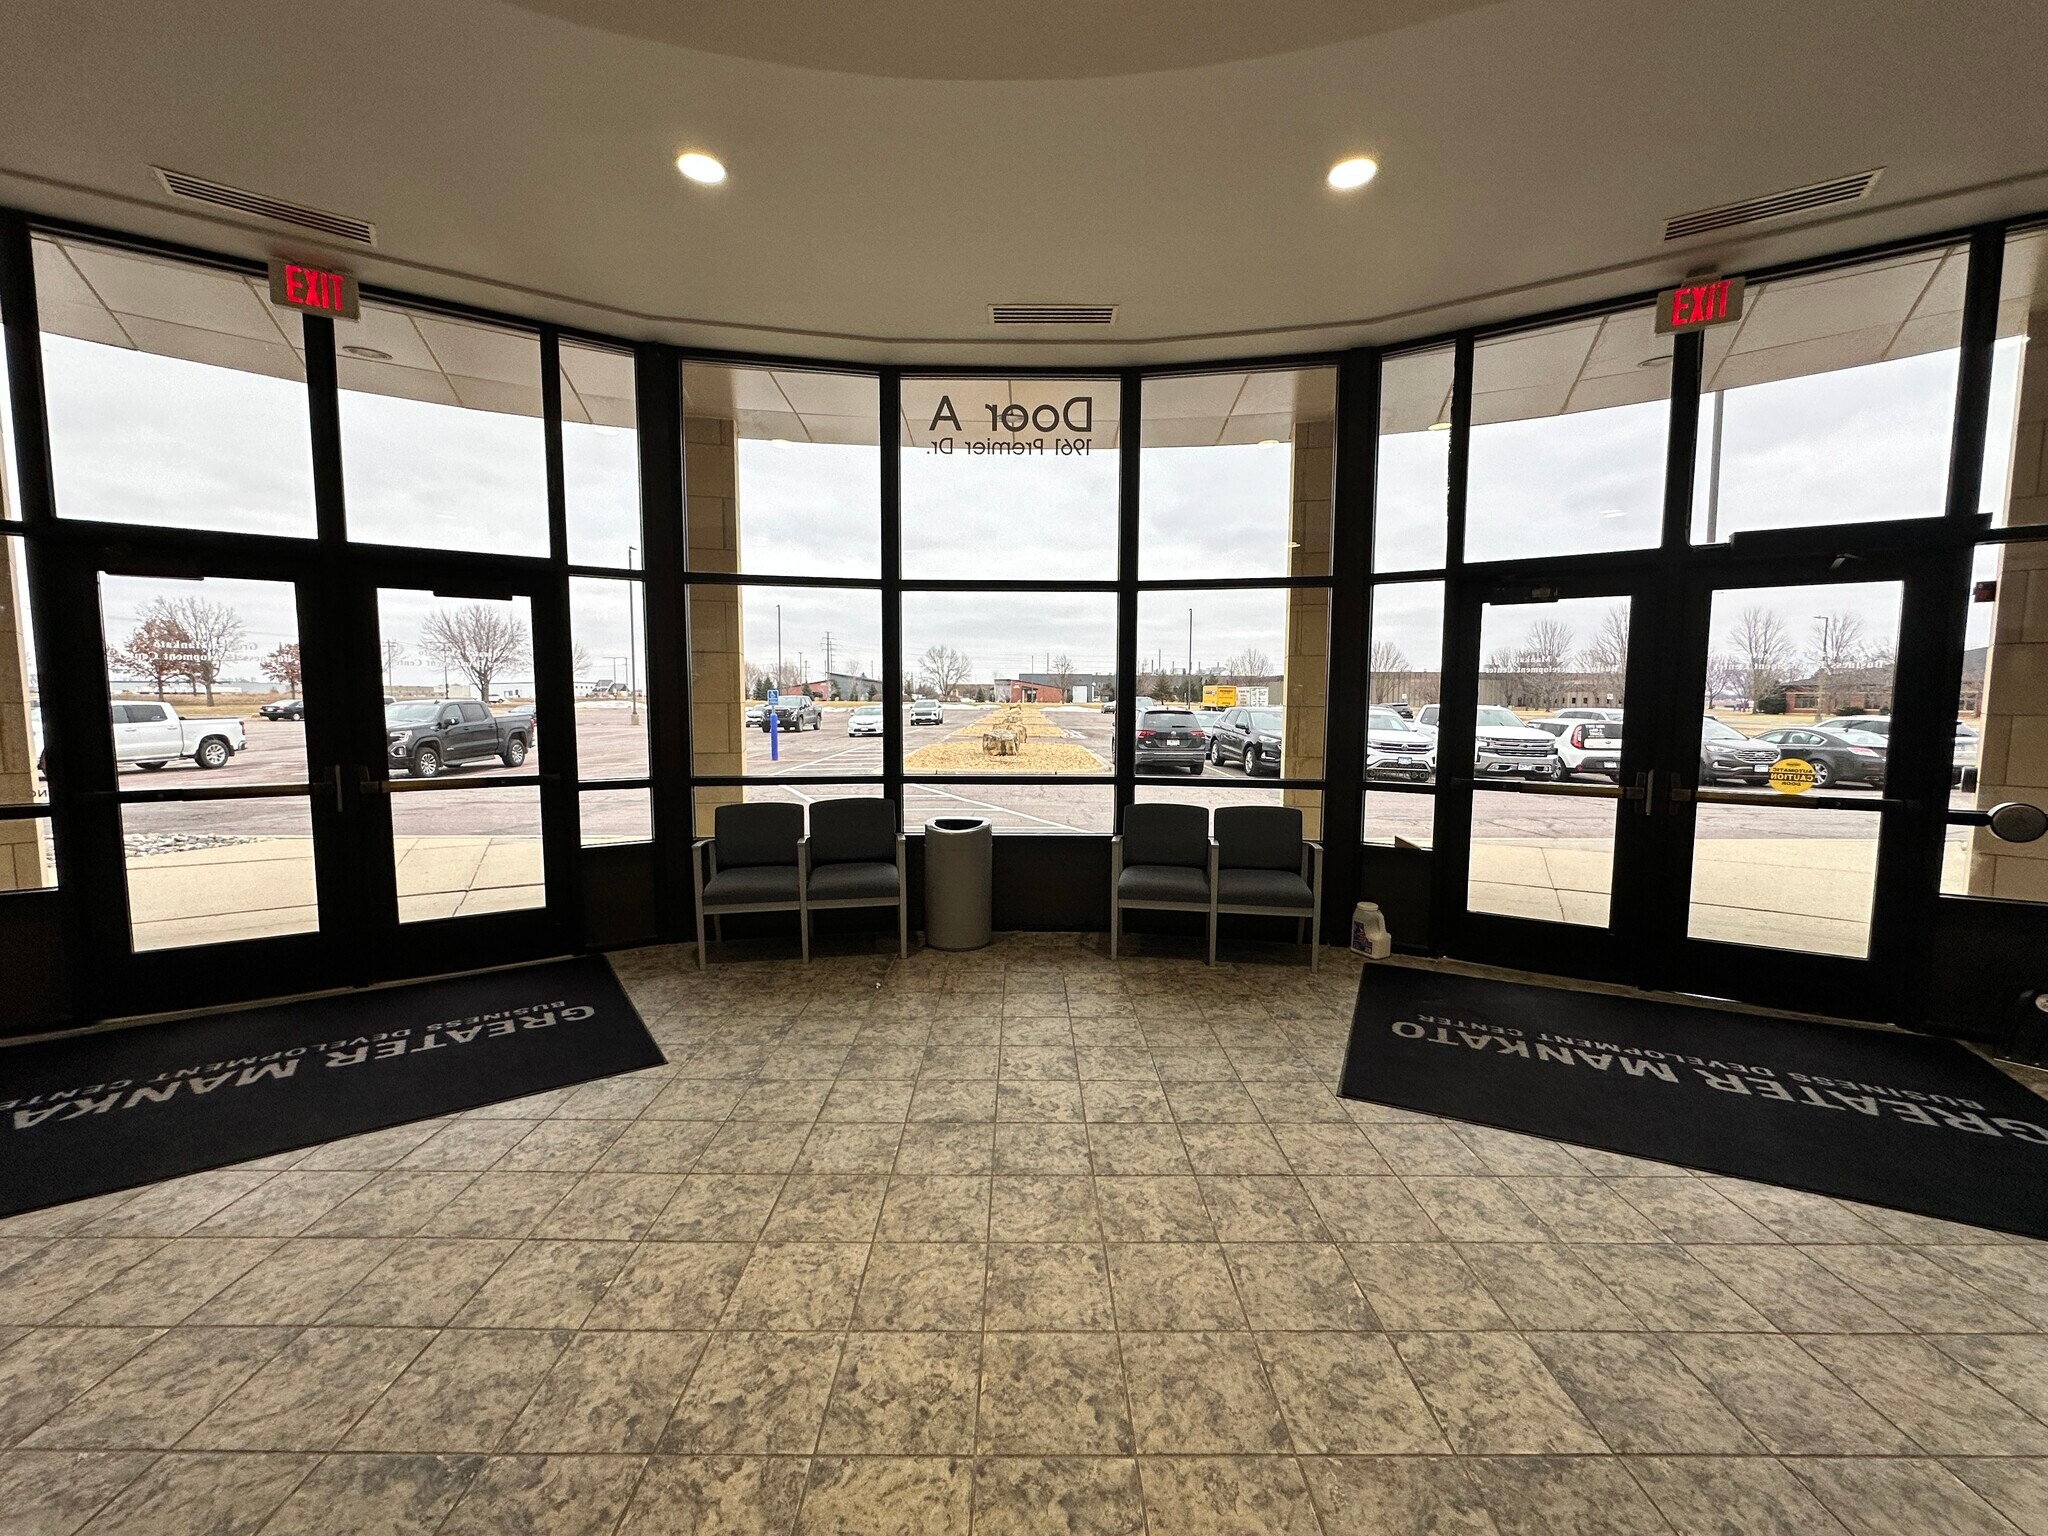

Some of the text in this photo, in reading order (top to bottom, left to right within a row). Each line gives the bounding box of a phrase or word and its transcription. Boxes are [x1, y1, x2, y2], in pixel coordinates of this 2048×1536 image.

[285, 264, 345, 311] EXIT
[1671, 280, 1732, 326] EXIT
[325, 1005, 595, 1068] GREATER
[426, 1000, 565, 1031] BUSINESS
[148, 1027, 411, 1083] DEVELOPMENT
[1418, 1014, 1986, 1112] BUSINESS DEVELOPMENT CENTER
[1392, 1021, 2048, 1146] GREATER MANKATO
